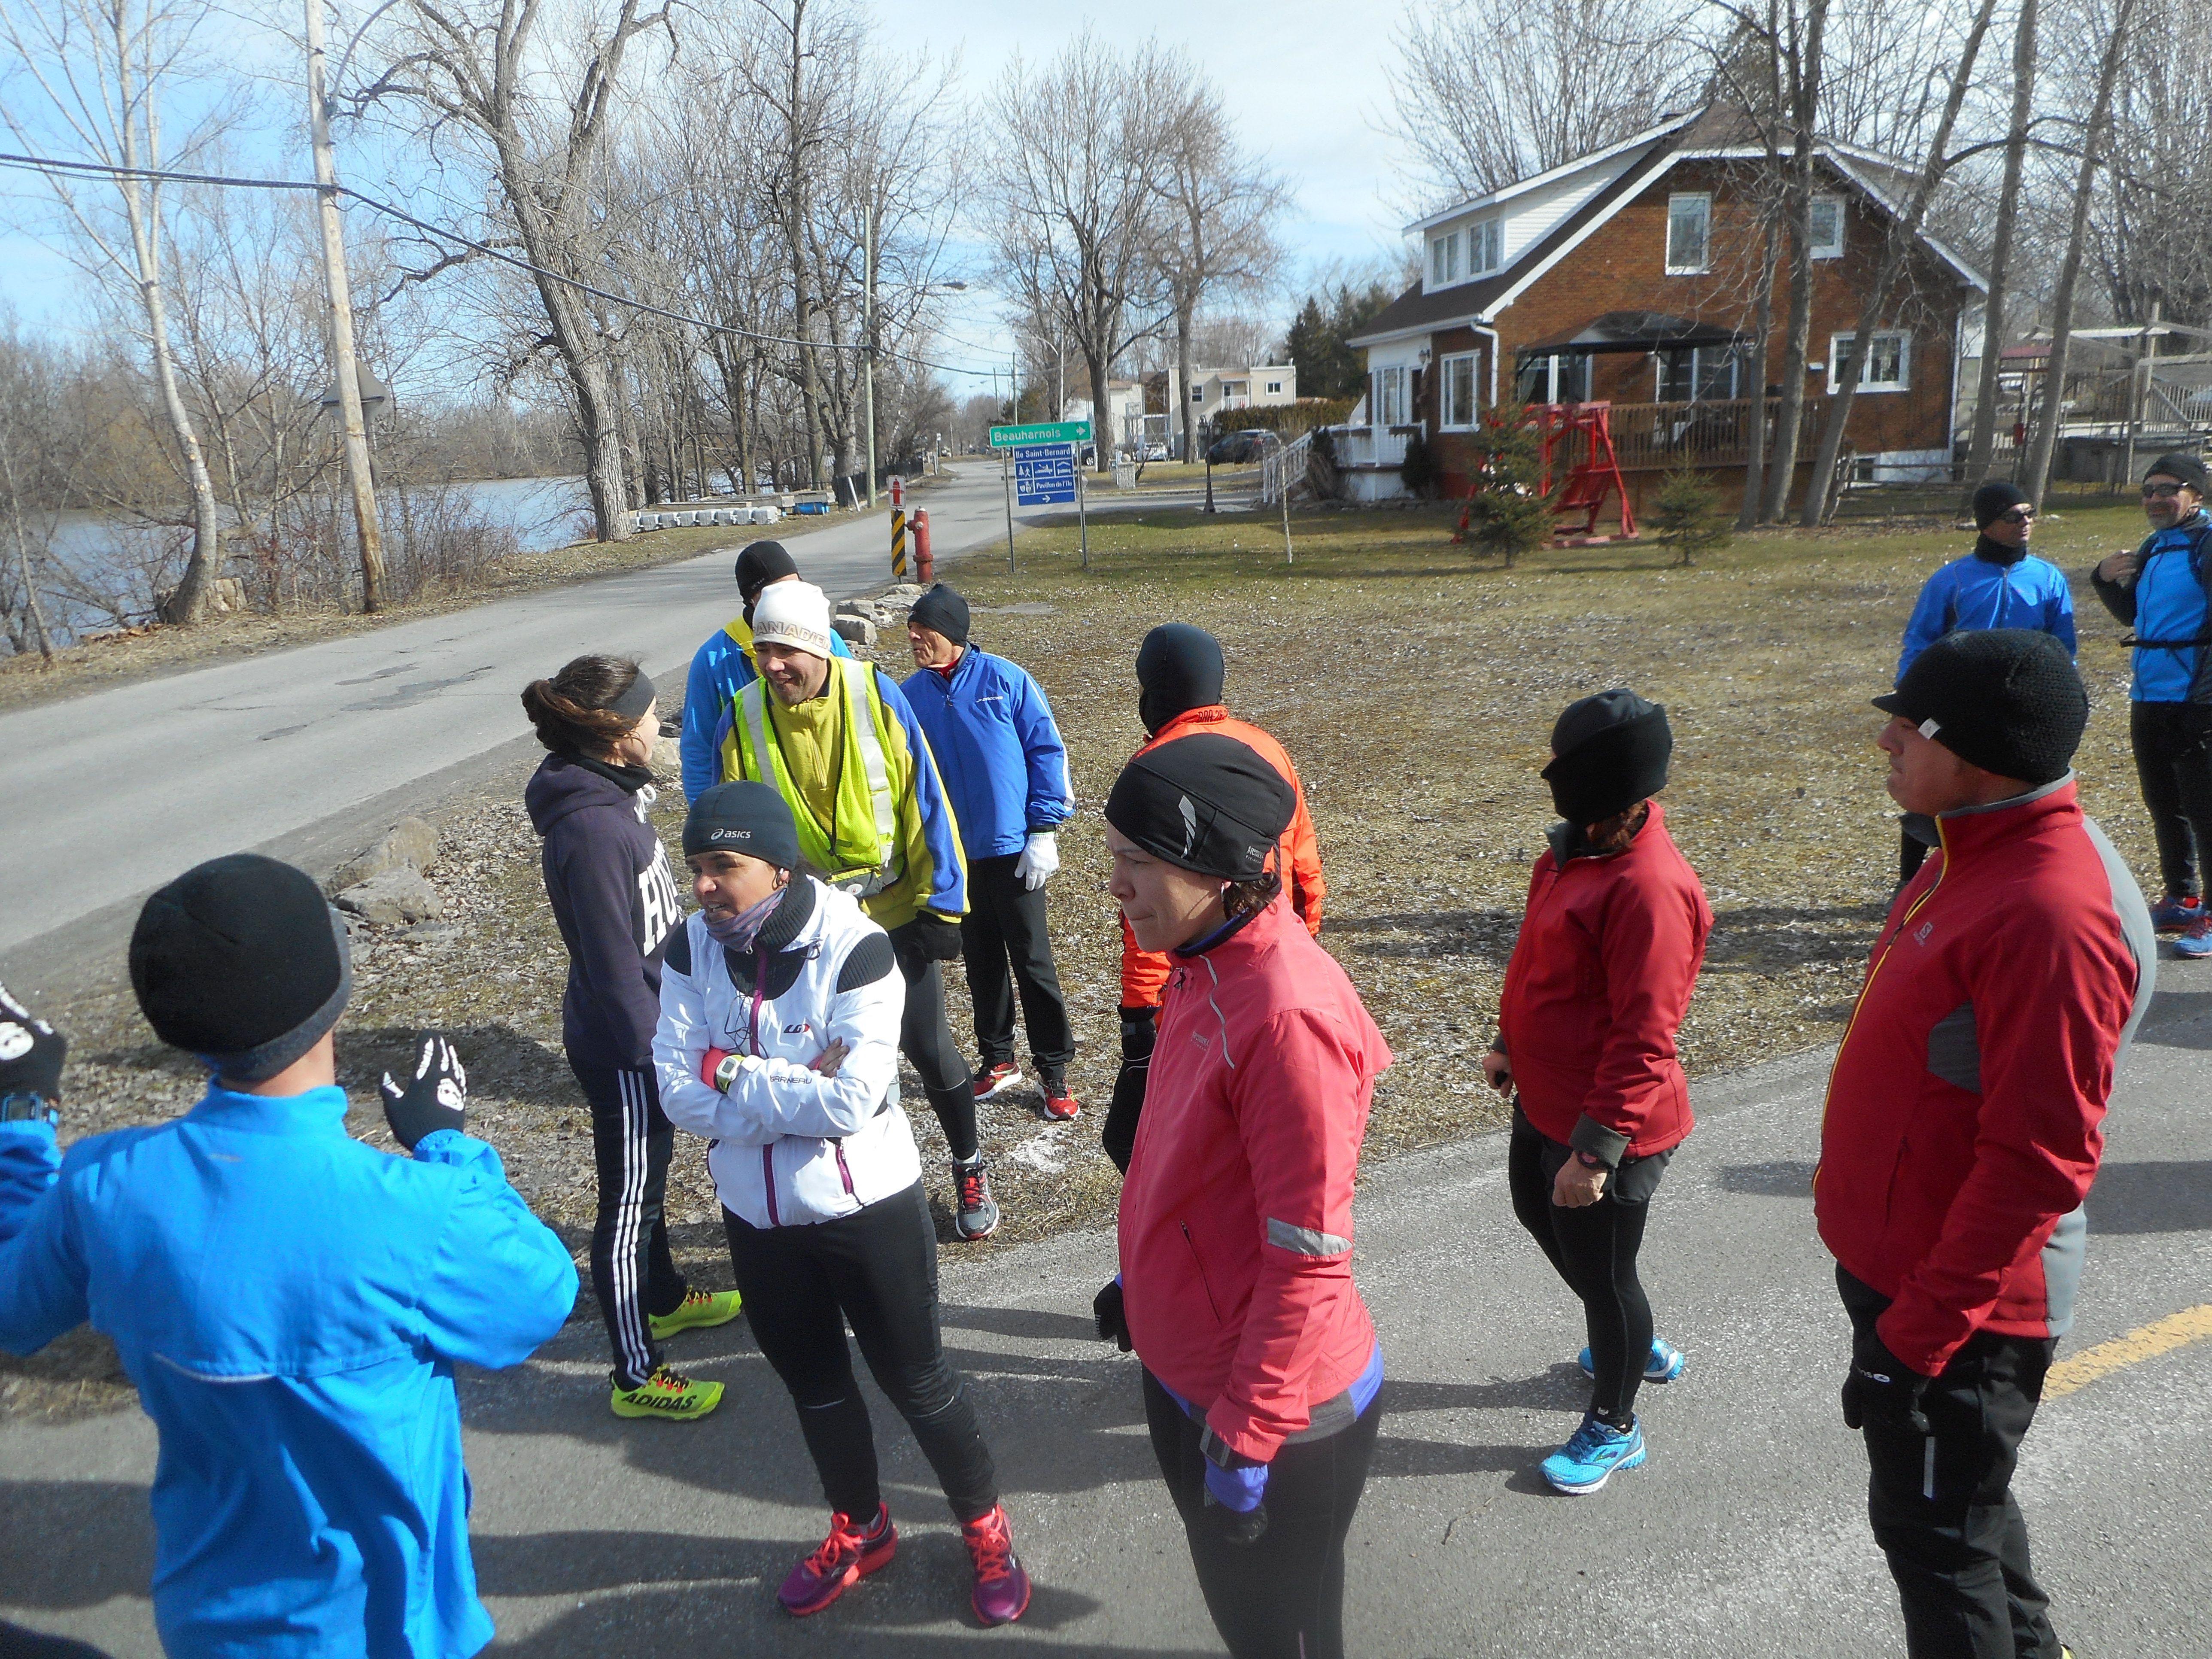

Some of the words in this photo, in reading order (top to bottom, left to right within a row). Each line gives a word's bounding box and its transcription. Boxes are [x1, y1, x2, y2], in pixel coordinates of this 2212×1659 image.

[994, 428, 1061, 442] Beauharnois
[1025, 447, 1070, 458] Saint-Bernard
[770, 1075, 812, 1084] GARNEAU
[621, 1393, 697, 1410] ADIDAS
